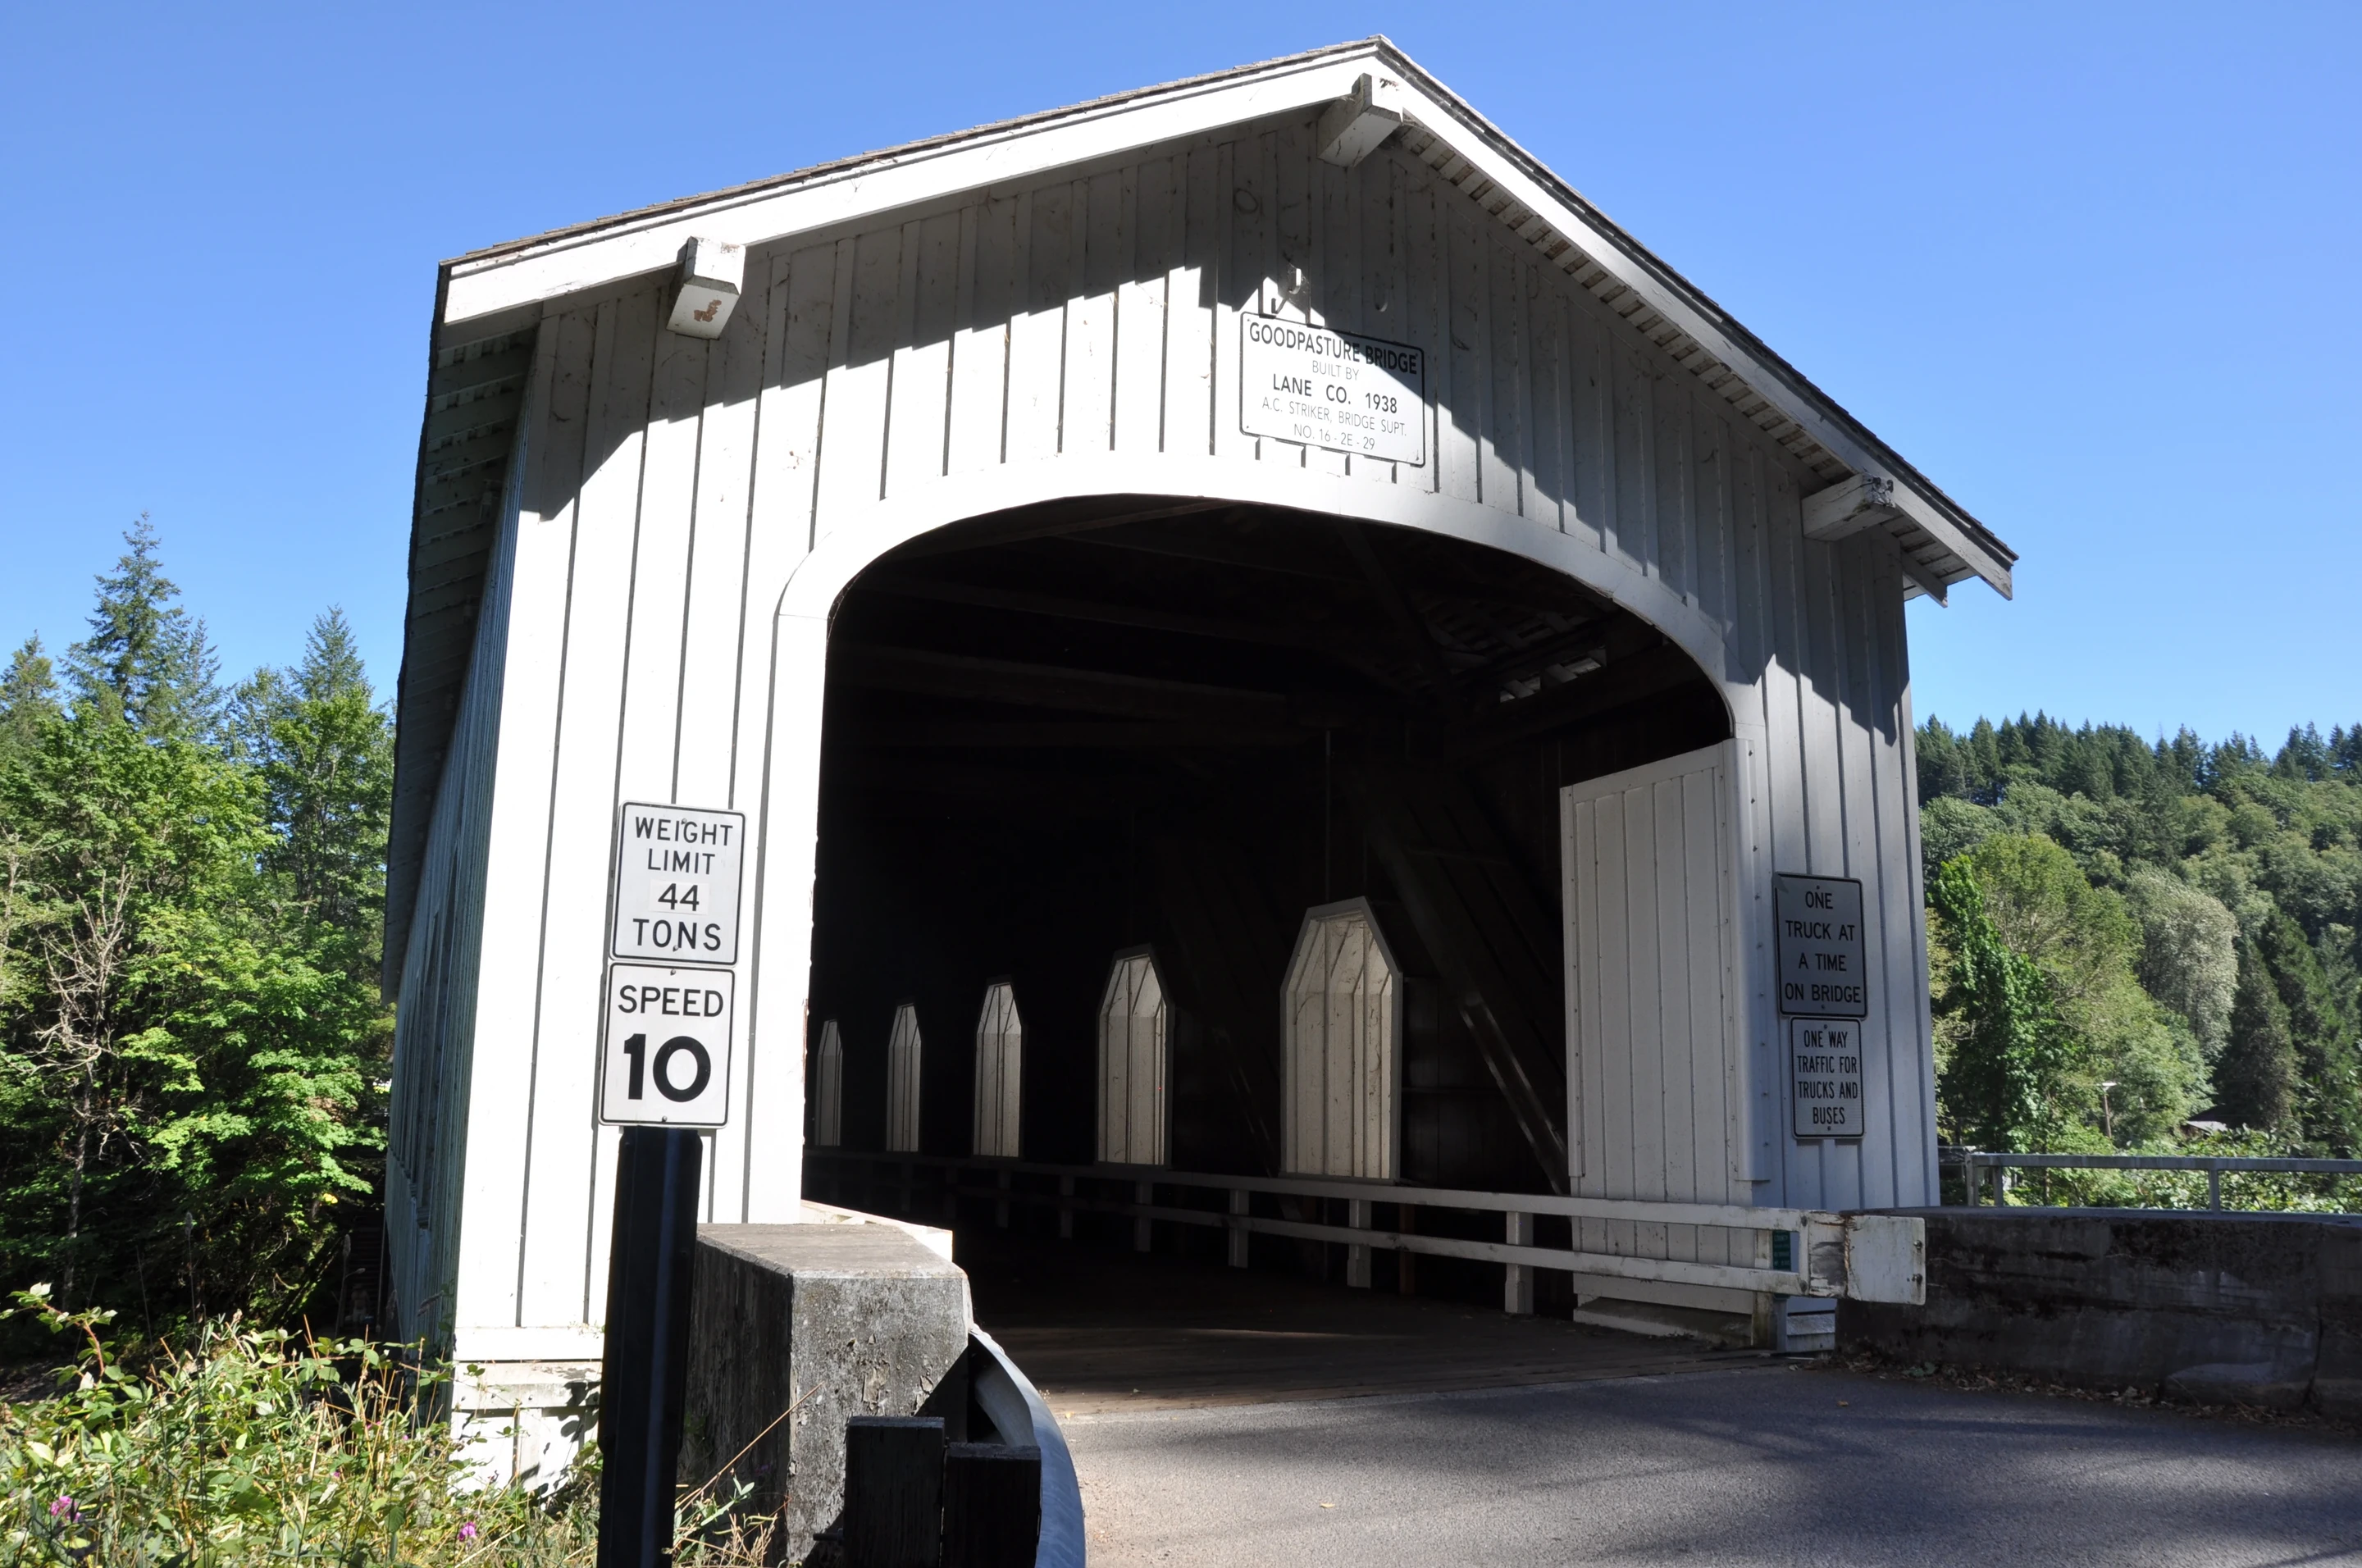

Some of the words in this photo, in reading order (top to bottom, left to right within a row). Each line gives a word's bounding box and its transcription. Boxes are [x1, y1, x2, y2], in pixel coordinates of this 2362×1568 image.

[1249, 321, 1361, 362] GOODPASTURE
[1365, 345, 1417, 375] BRIDGE
[1312, 360, 1342, 377] BUILT
[1346, 367, 1360, 381] BY
[1273, 373, 1312, 397] LANE
[1326, 385, 1352, 404] CO.
[1366, 393, 1398, 414] 1938
[1289, 401, 1333, 423] STRIKER,
[1338, 411, 1375, 431] BRIDGE
[1381, 419, 1407, 436] SUPT.
[1293, 424, 1315, 440] NO.
[635, 816, 733, 846] WEIGHT
[647, 848, 716, 875] LIMIT
[658, 882, 700, 912] 44
[1804, 891, 1834, 909] ONE
[632, 918, 721, 951] TONS
[1785, 920, 1831, 940] TRUCK
[1839, 924, 1855, 941] AT
[1799, 952, 1809, 969] A
[1815, 954, 1847, 972] TIME
[618, 984, 724, 1018] SPEED
[1785, 982, 1804, 1001] ON
[1811, 984, 1862, 1003] BRIDGE
[1803, 1030, 1823, 1048] ONE
[1828, 1032, 1849, 1049] WAY
[623, 1032, 712, 1103] 10
[1797, 1055, 1835, 1073] TRAFFIC
[1839, 1056, 1858, 1074] FOR
[1797, 1081, 1835, 1099] TRUCKS
[1839, 1083, 1858, 1100] AND
[1813, 1107, 1845, 1125] BUSES
